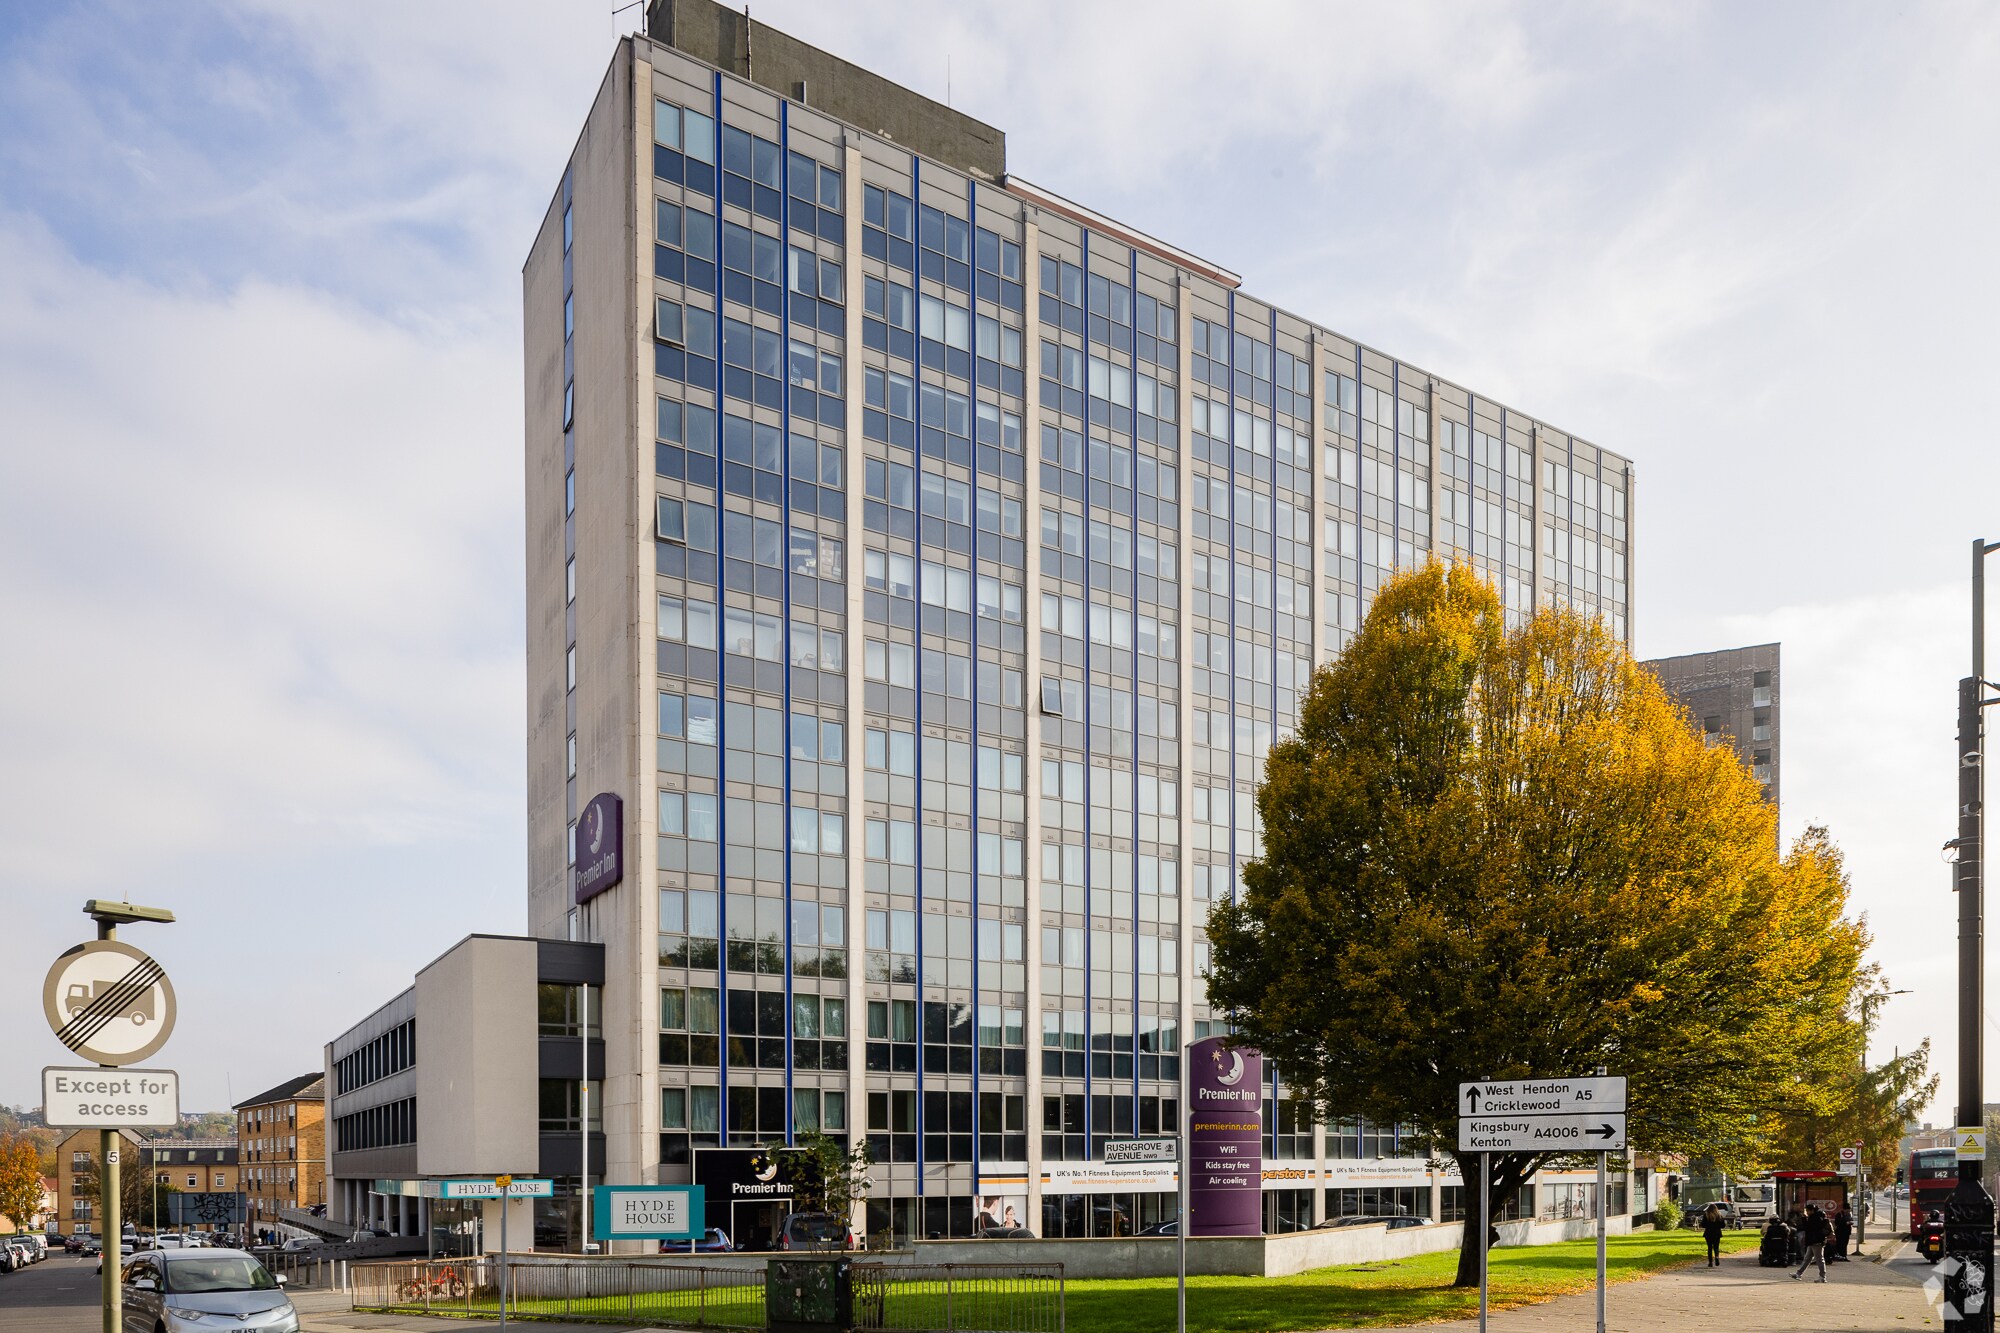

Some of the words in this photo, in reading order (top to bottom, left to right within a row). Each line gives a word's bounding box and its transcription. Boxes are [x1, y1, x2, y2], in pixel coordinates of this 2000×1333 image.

[576, 860, 603, 892] Premier
[603, 852, 615, 874] Inn
[55, 1076, 131, 1096] Except
[139, 1079, 169, 1095] for
[1484, 1085, 1515, 1096] West
[1522, 1083, 1570, 1095] Hendon
[1199, 1088, 1241, 1100] Premier
[1241, 1089, 1256, 1101] Inn
[1575, 1090, 1593, 1101] A5
[78, 1103, 149, 1116] access
[1484, 1099, 1561, 1112] Cricklewood
[1194, 1121, 1259, 1132] premierinn.com
[1470, 1122, 1530, 1134] Kingsbury
[1534, 1127, 1579, 1139] A4006
[1106, 1143, 1162, 1152] RUSHGROVE
[1470, 1137, 1512, 1148] Kenton
[1219, 1146, 1238, 1154] WiFi
[109, 1152, 118, 1163] 5
[1106, 1152, 1142, 1160] AVENUE
[1205, 1161, 1221, 1169] Kids
[1222, 1162, 1236, 1171] stay
[1237, 1161, 1250, 1169] free
[1111, 1169, 1141, 1177] Equipment
[1262, 1168, 1306, 1181] perstore
[1934, 1170, 1948, 1179] 142
[1209, 1176, 1222, 1185] Air
[1222, 1176, 1248, 1186] cooling
[458, 1184, 494, 1194] HYDE
[731, 1182, 776, 1194] Premier
[777, 1182, 794, 1193] Inn
[625, 1200, 676, 1211] HYDE
[625, 1213, 676, 1224] HOUSE
